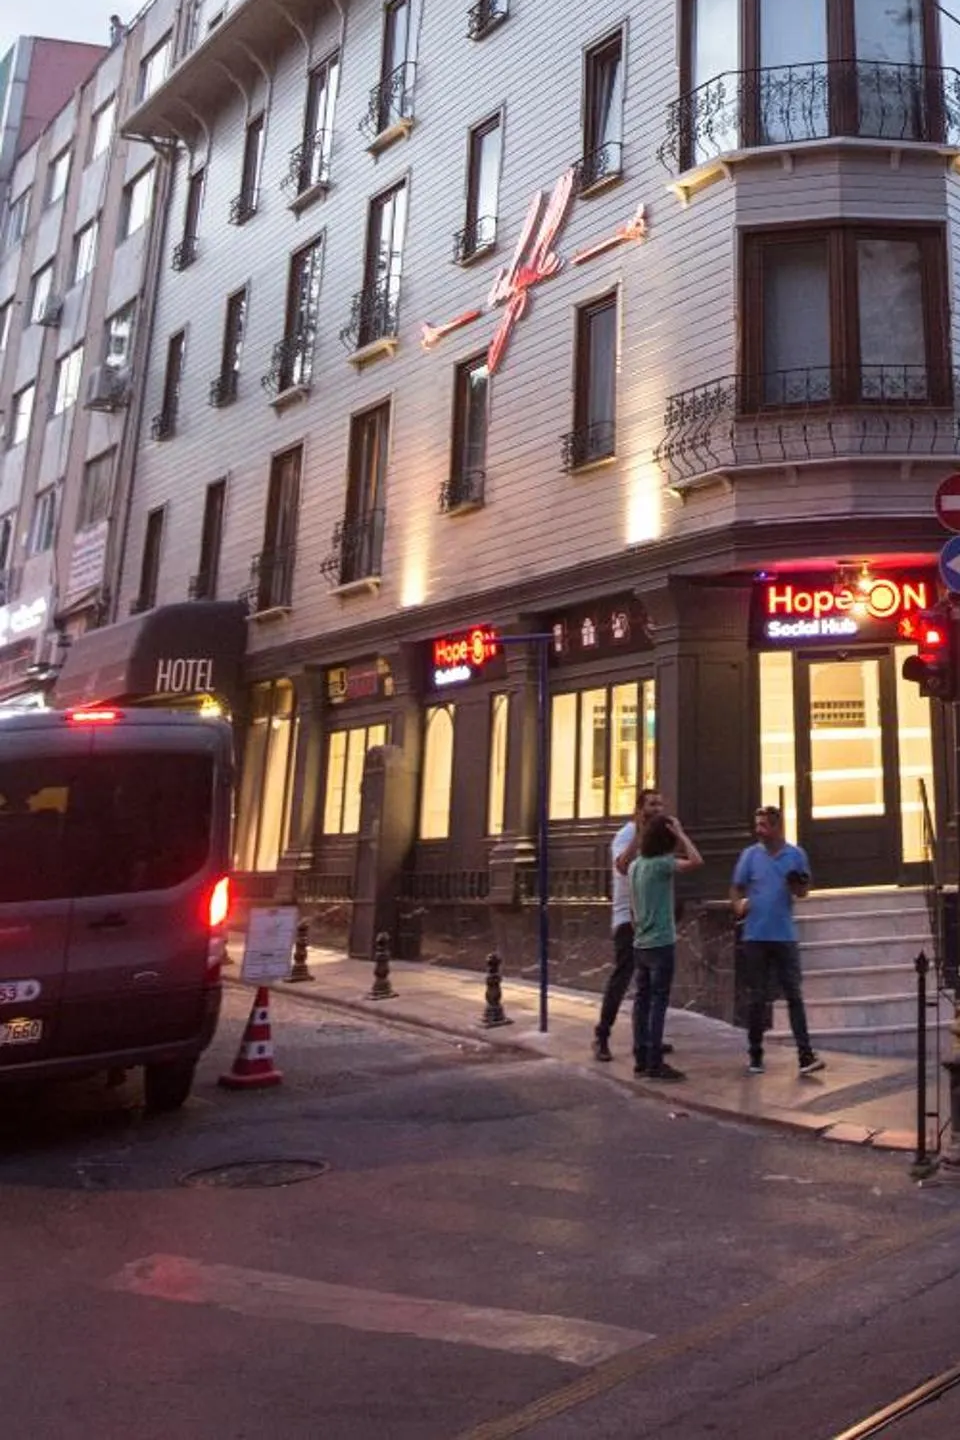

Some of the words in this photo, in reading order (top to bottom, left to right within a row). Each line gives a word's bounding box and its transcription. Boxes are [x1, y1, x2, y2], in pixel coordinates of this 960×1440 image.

[767, 620, 818, 637] Social
[822, 618, 858, 635] Hub
[155, 659, 215, 692] HOTEL
